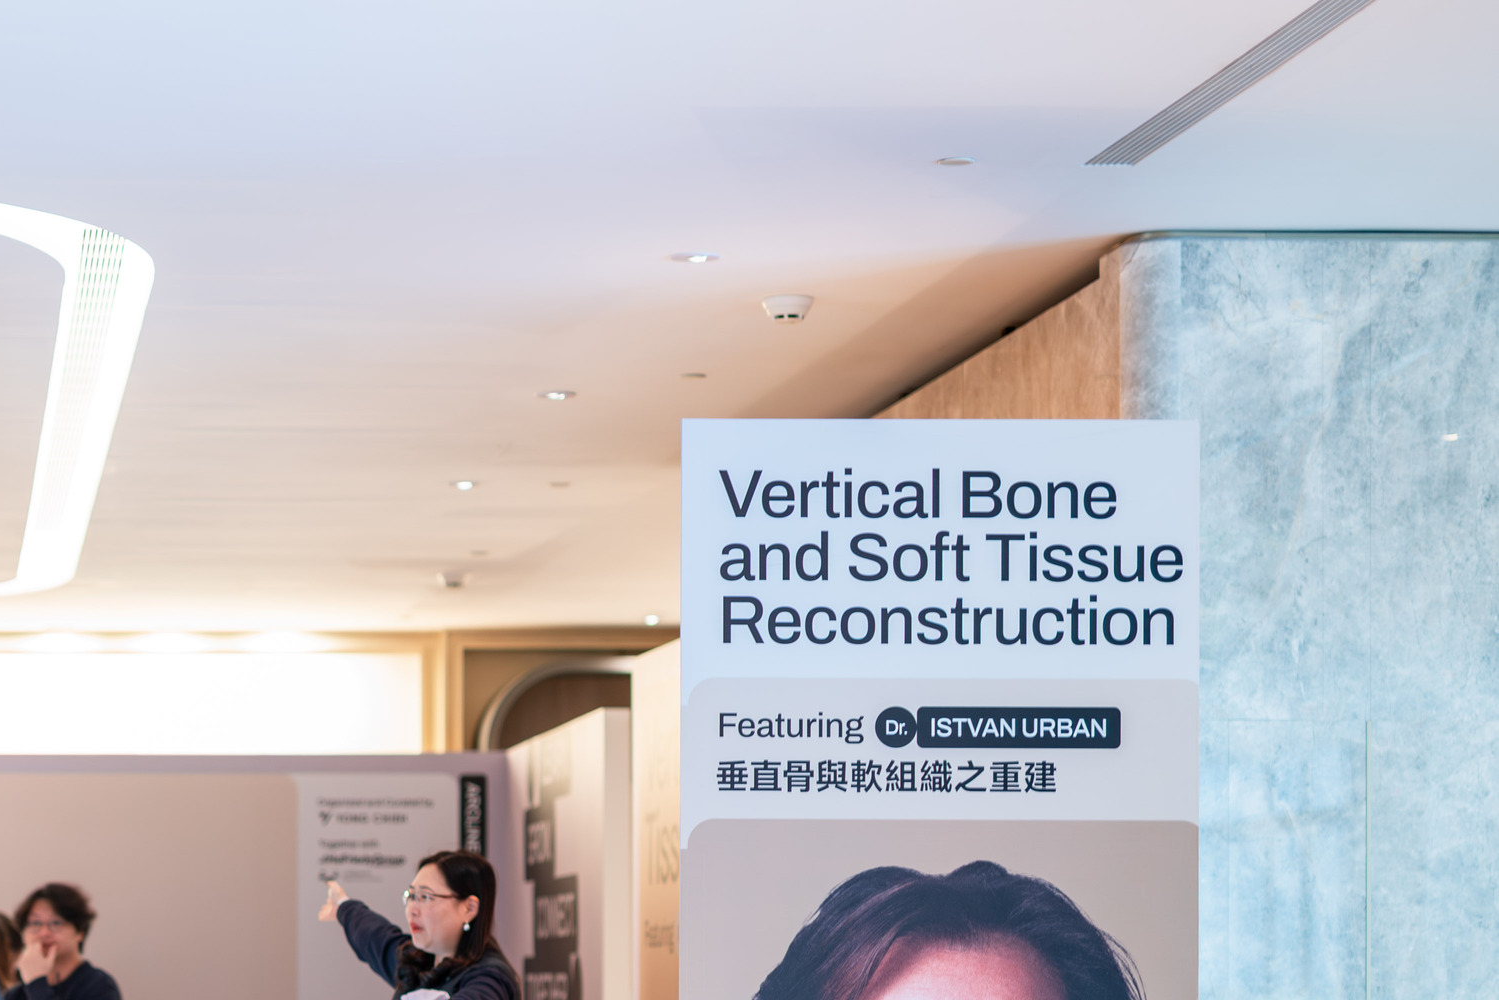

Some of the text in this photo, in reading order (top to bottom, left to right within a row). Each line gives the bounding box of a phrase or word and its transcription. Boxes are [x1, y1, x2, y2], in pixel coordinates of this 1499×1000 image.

[718, 467, 1118, 520] Vertical Bone
[719, 530, 1185, 584] and Soft Tissue
[721, 594, 1176, 647] Reconstruction
[717, 711, 1108, 745] Featuring Dr. ISTVAN URBAN
[716, 759, 1058, 794] 垂直骨與軟組織之重建
[646, 812, 680, 884] Tiss
